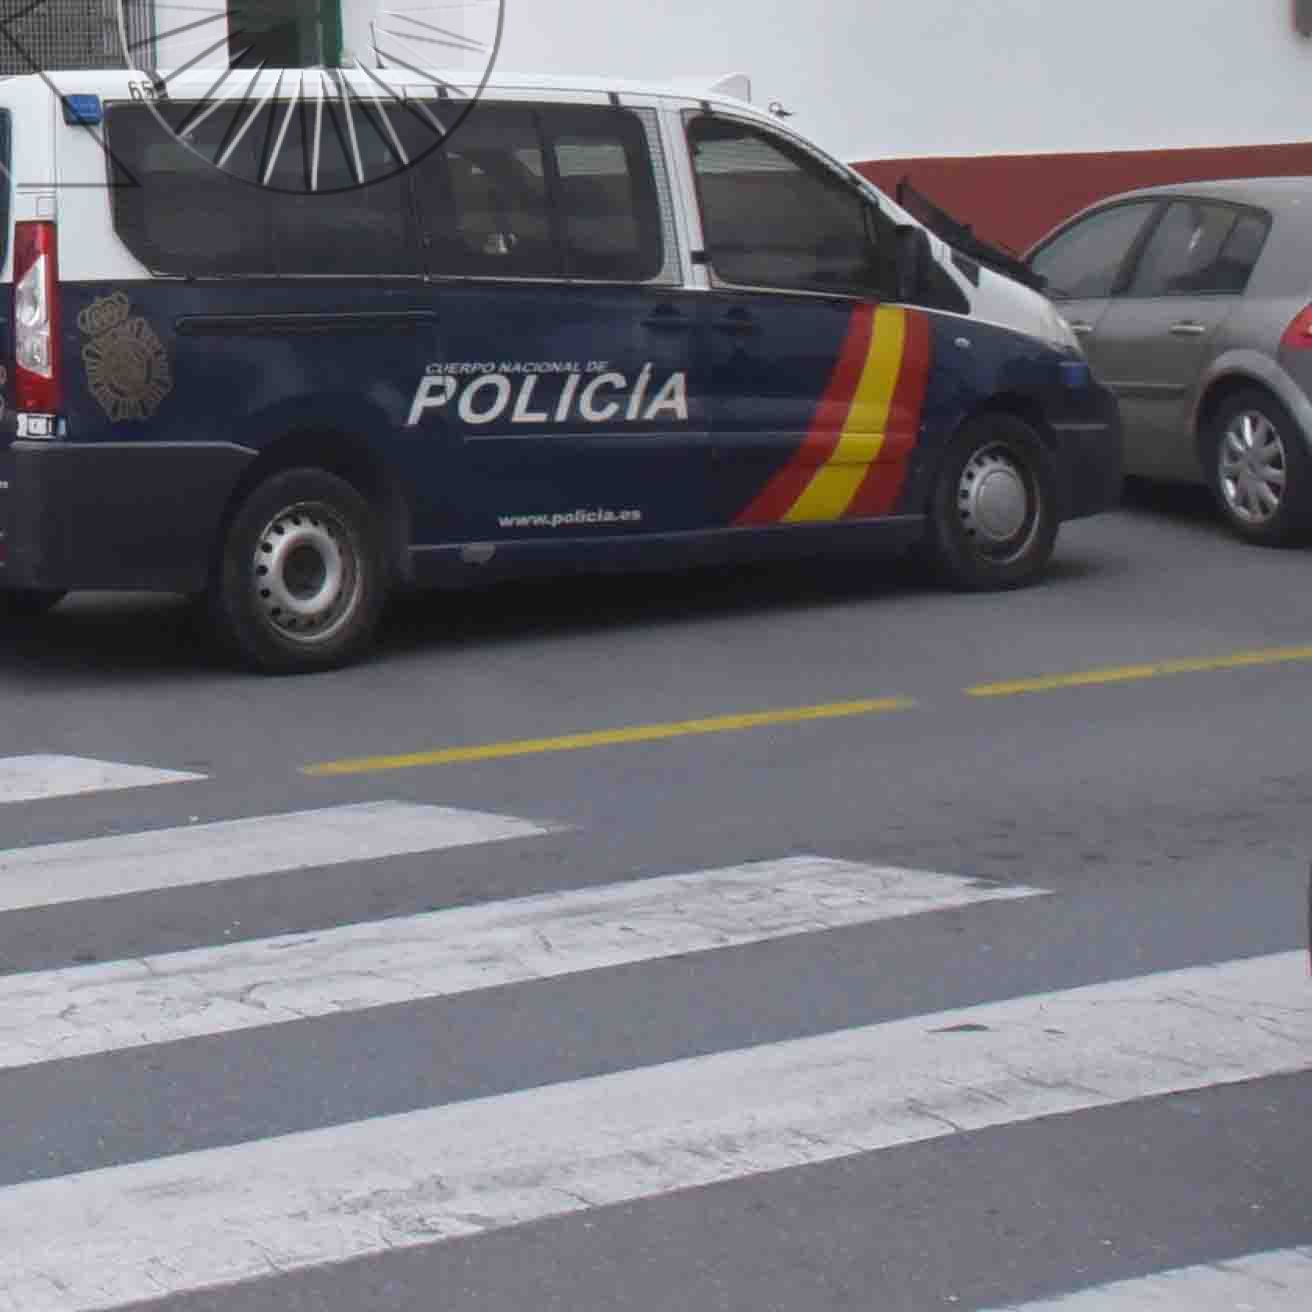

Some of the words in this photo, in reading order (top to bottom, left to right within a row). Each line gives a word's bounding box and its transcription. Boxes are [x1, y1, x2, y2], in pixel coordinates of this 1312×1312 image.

[426, 361, 496, 375] CUERPO
[499, 360, 581, 374] NACIONAL
[586, 360, 609, 373] DE
[406, 361, 689, 426] POLICÍA
[497, 507, 642, 528] www.policia.es
